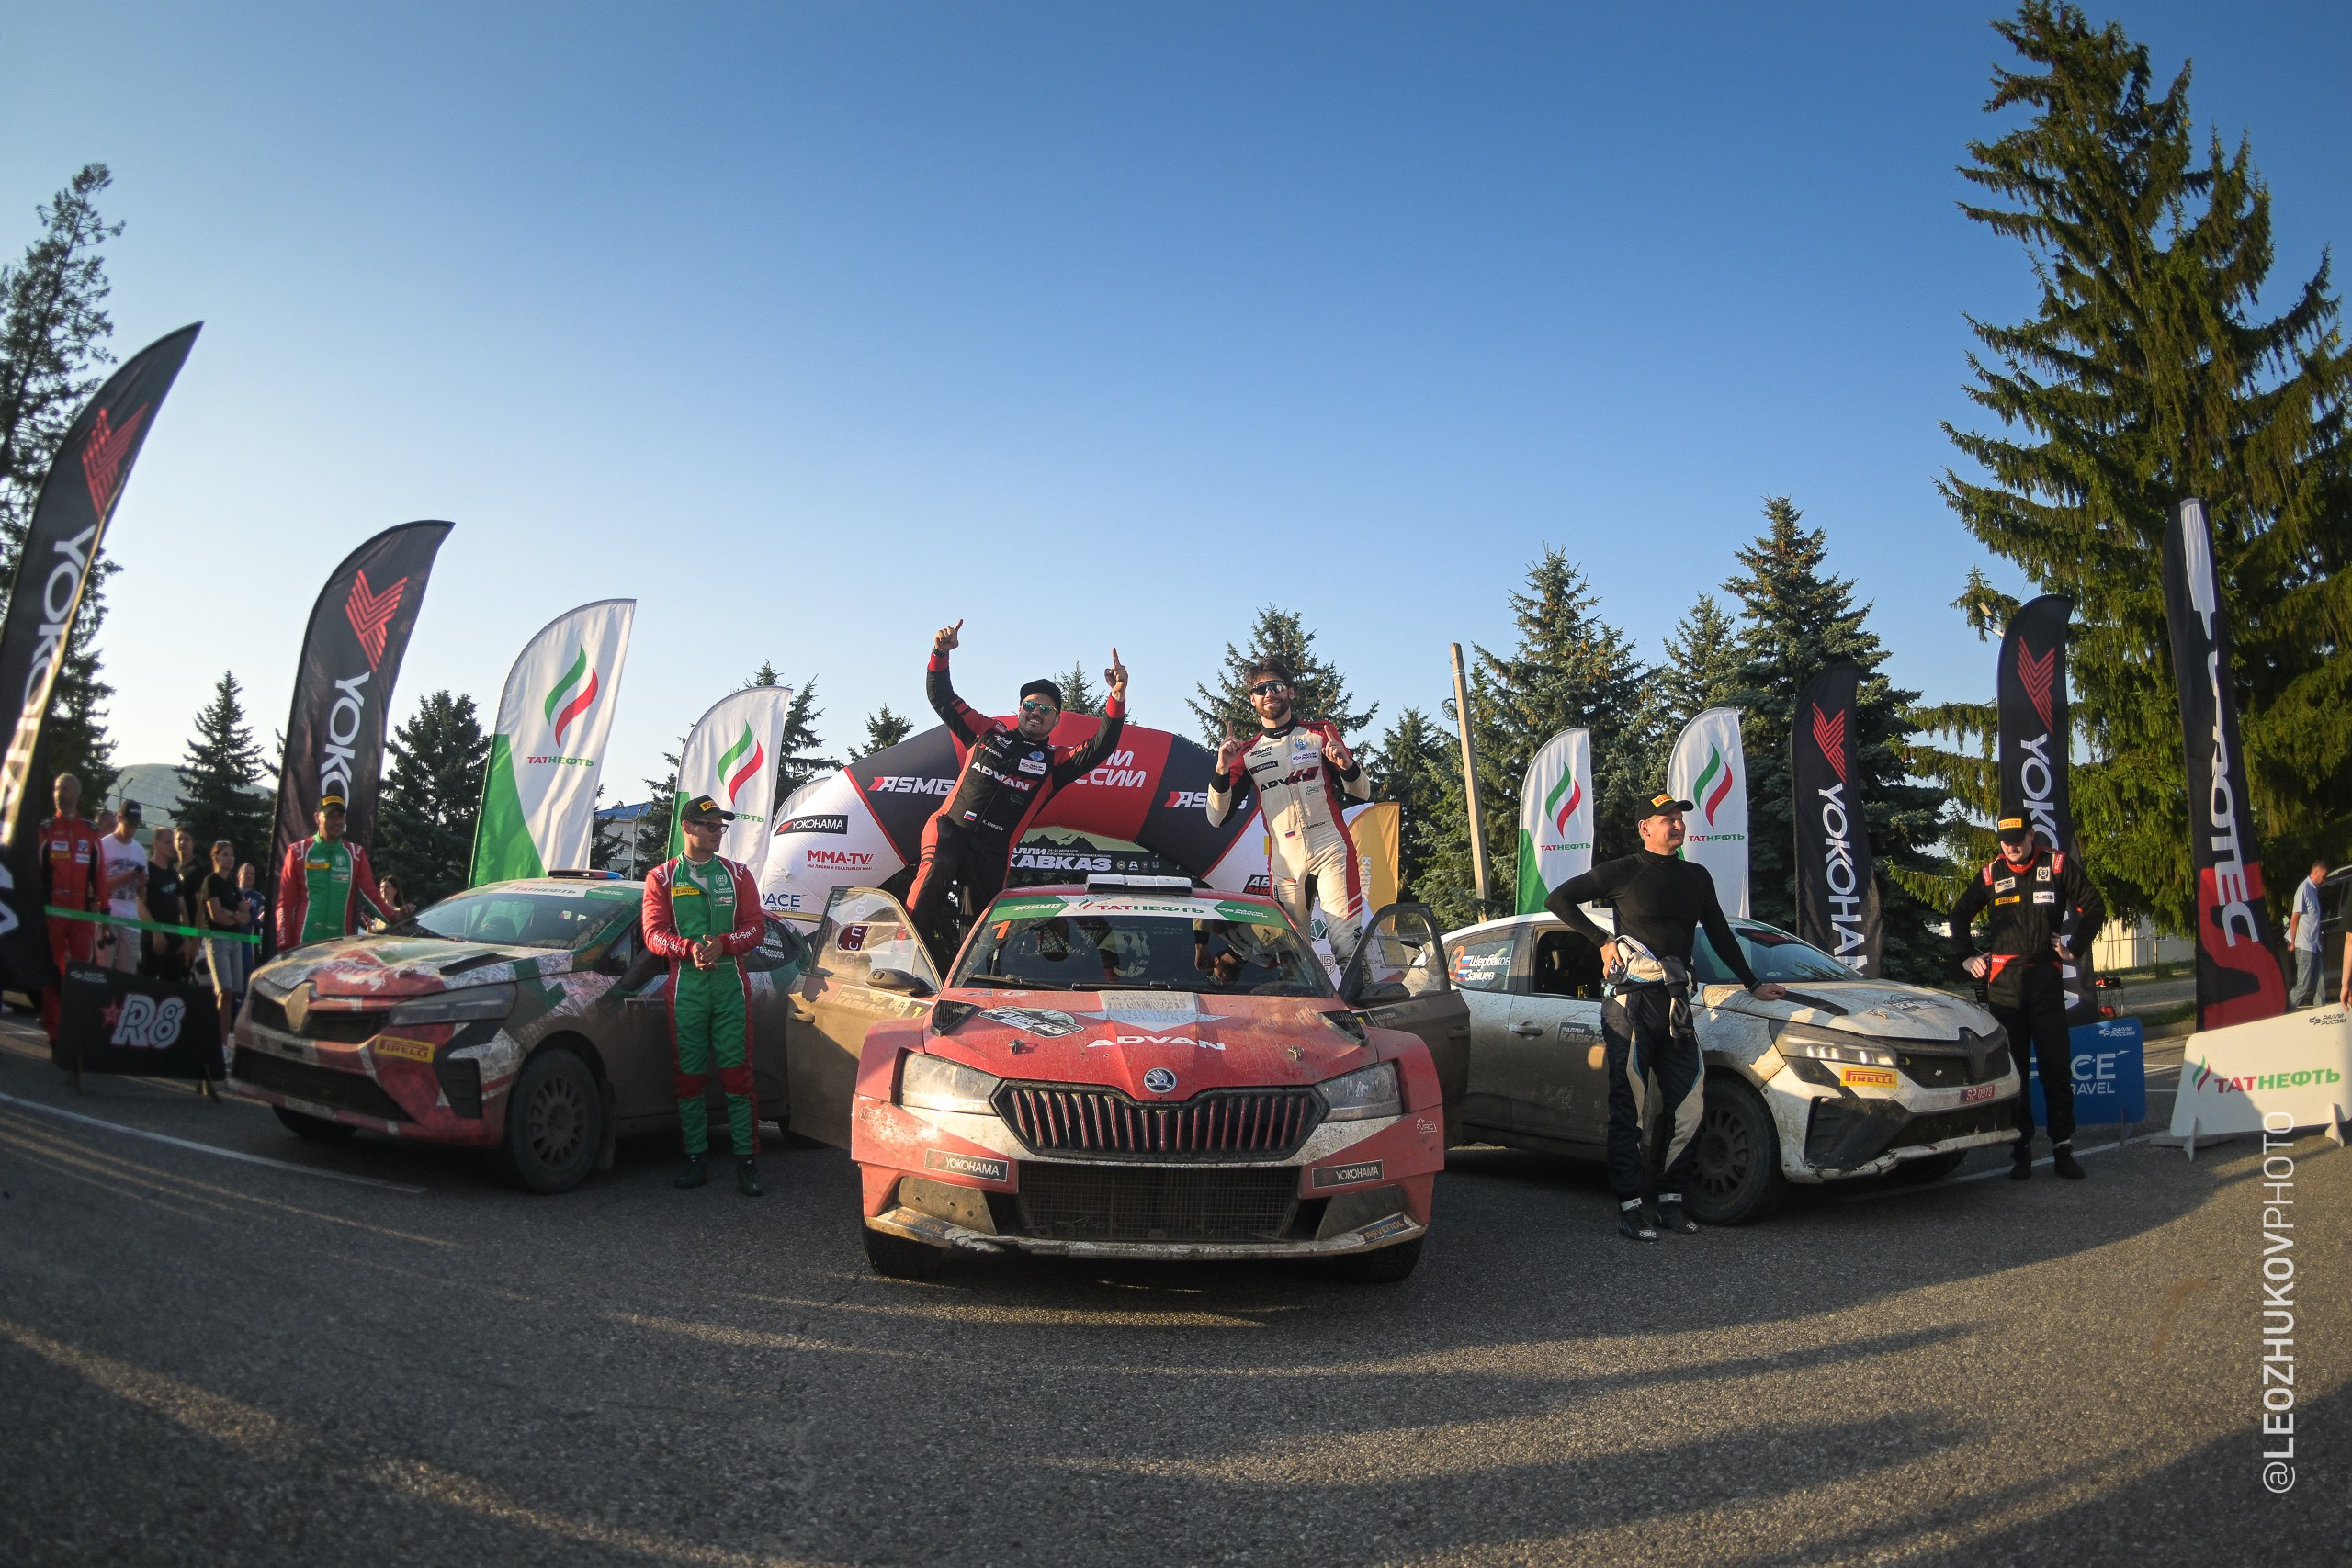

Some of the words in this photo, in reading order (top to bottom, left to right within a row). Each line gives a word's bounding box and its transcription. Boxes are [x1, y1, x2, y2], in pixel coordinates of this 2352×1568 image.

[526, 755, 594, 768] ТАТНЕФТЬ
[971, 761, 1030, 791] ADVAN
[1260, 772, 1317, 792] ADVAN
[792, 818, 843, 829] YOKOHAMA
[1012, 847, 1047, 855] АЛЛИ
[1096, 905, 1205, 914] ТАТНЕФТЬ
[992, 920, 1012, 939] 1
[1448, 945, 1465, 980] 3
[1470, 954, 1511, 971] Щербаков
[1465, 969, 1496, 982] Зайцев
[111, 993, 187, 1048] R8
[379, 1038, 429, 1058] PIRELLI
[1085, 1035, 1226, 1051] ADVAN
[1845, 1070, 1894, 1085] PIRELLI
[2214, 1068, 2341, 1094] ТАТНЕФТЬ
[2072, 1082, 2115, 1096] RAVEL
[945, 1156, 1000, 1176] YOKOHAMA
[1335, 1165, 1379, 1181] YOKOHAMA
[896, 1212, 943, 1234] RAVENOL
[1363, 1219, 1405, 1240] RAVENOL
